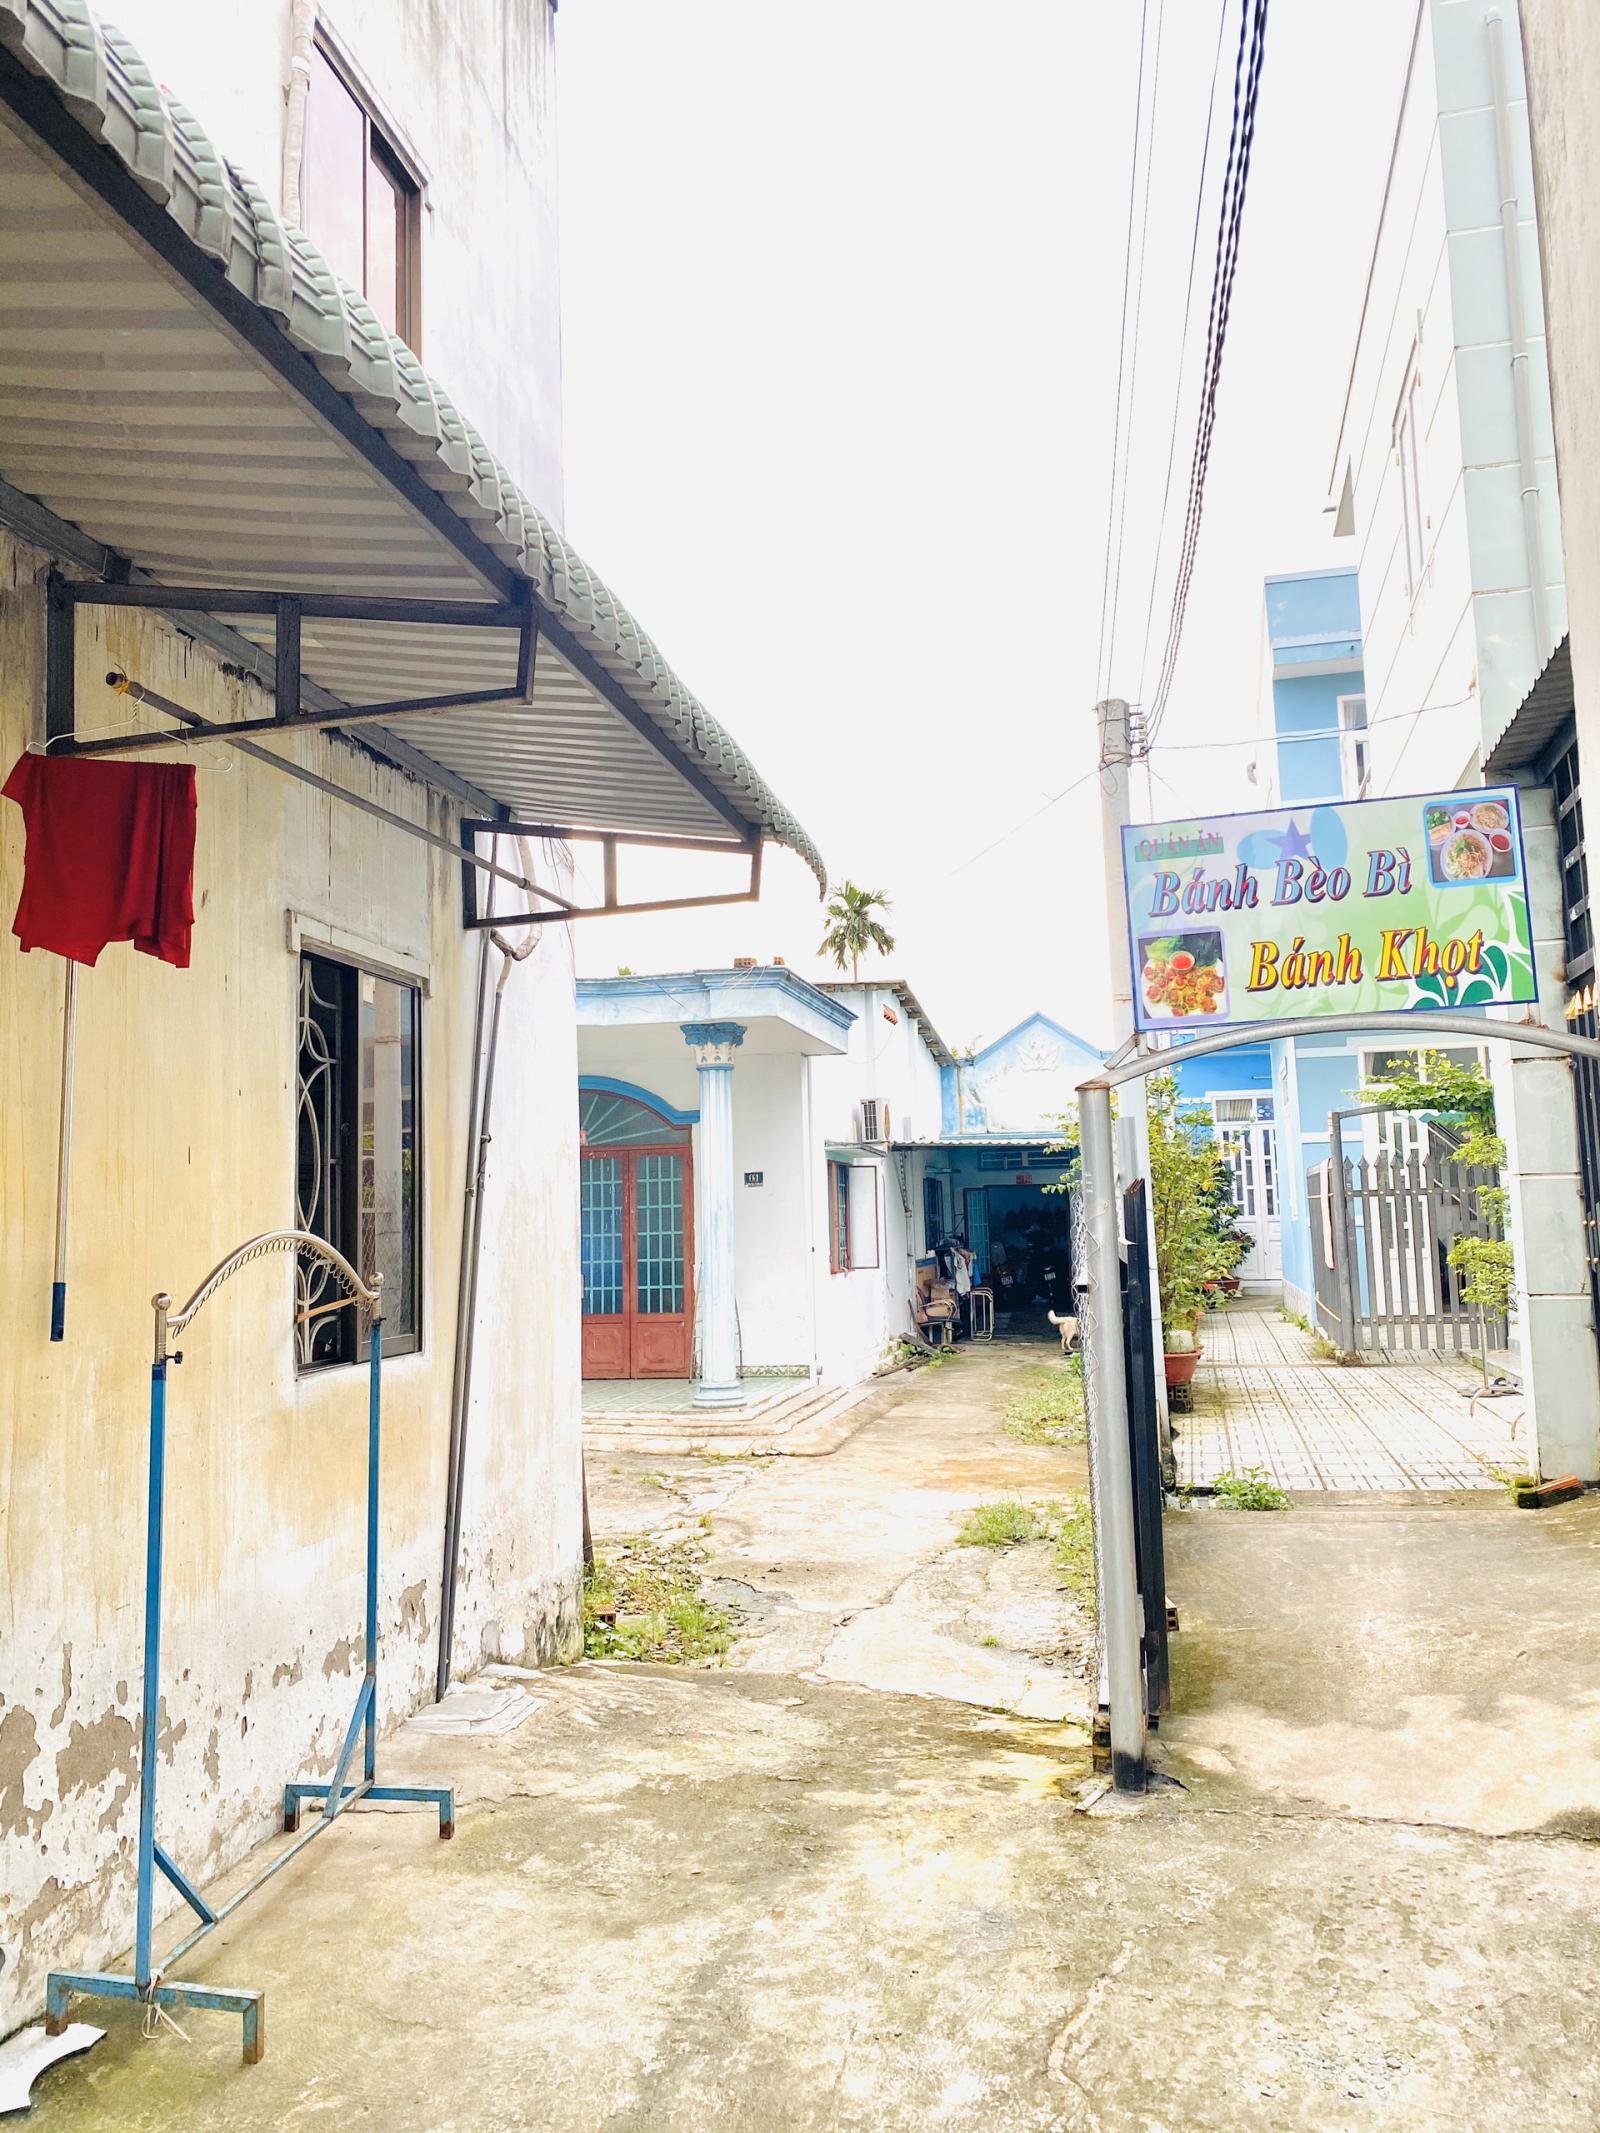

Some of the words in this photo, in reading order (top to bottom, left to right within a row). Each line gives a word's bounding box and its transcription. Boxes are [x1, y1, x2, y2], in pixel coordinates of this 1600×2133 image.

[1148, 863, 1259, 917] Bánh
[1270, 856, 1351, 906] Bèo
[1362, 847, 1412, 897] Bì
[1245, 933, 1364, 992] Bánh
[1375, 926, 1484, 990] Khọt
